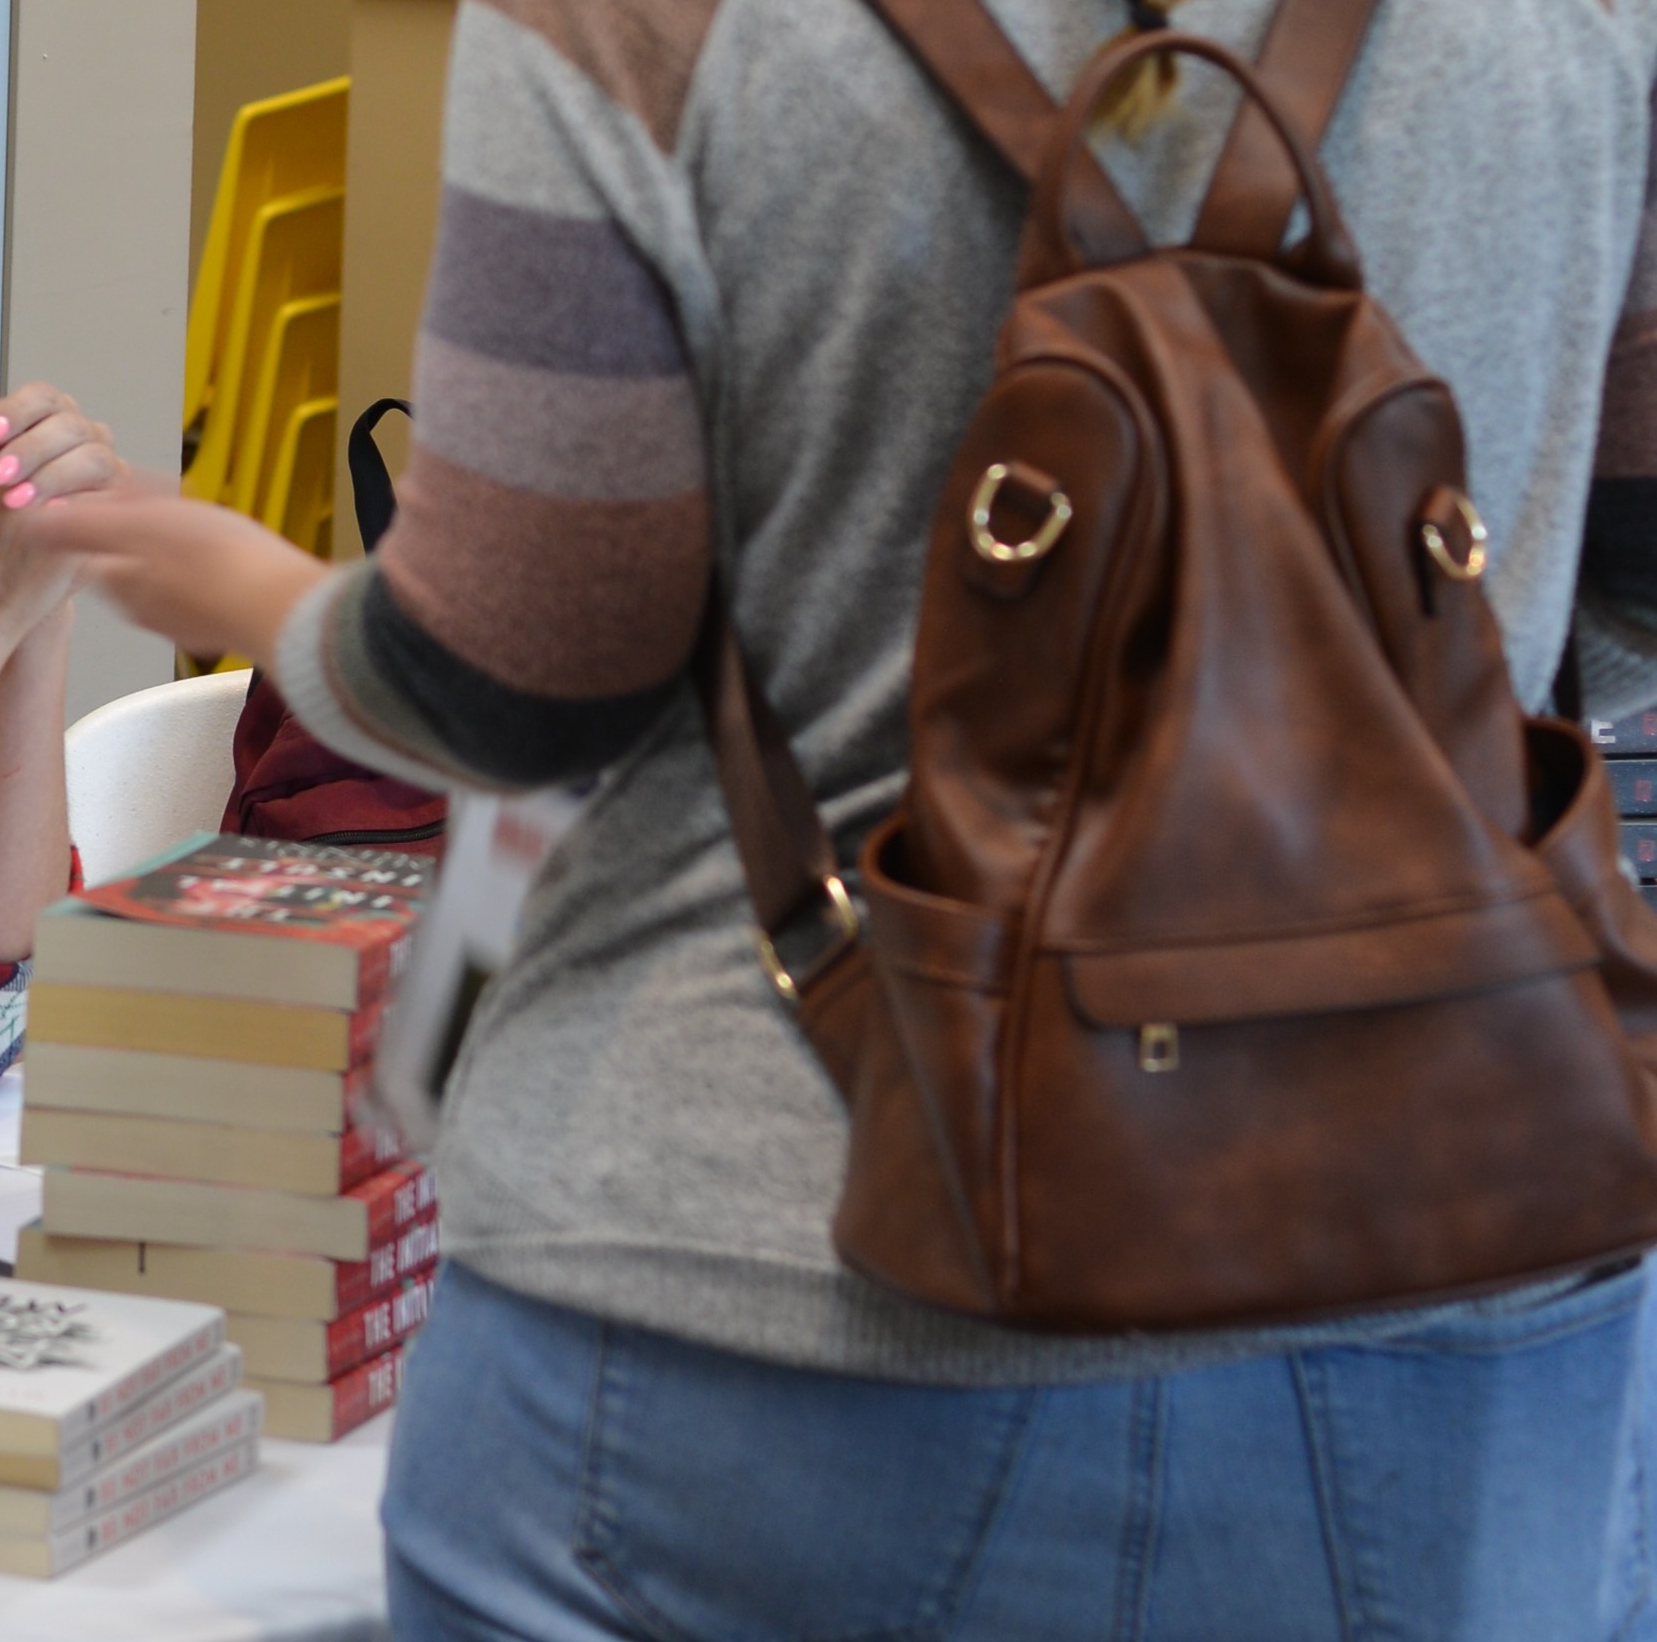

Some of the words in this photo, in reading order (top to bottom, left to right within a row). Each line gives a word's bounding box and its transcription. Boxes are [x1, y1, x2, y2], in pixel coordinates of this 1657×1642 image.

[394, 1181, 414, 1225] THE
[371, 1241, 394, 1288] THE
[396, 1221, 437, 1272] INITIA
[364, 1301, 389, 1349] THE
[368, 1361, 391, 1408] THE
